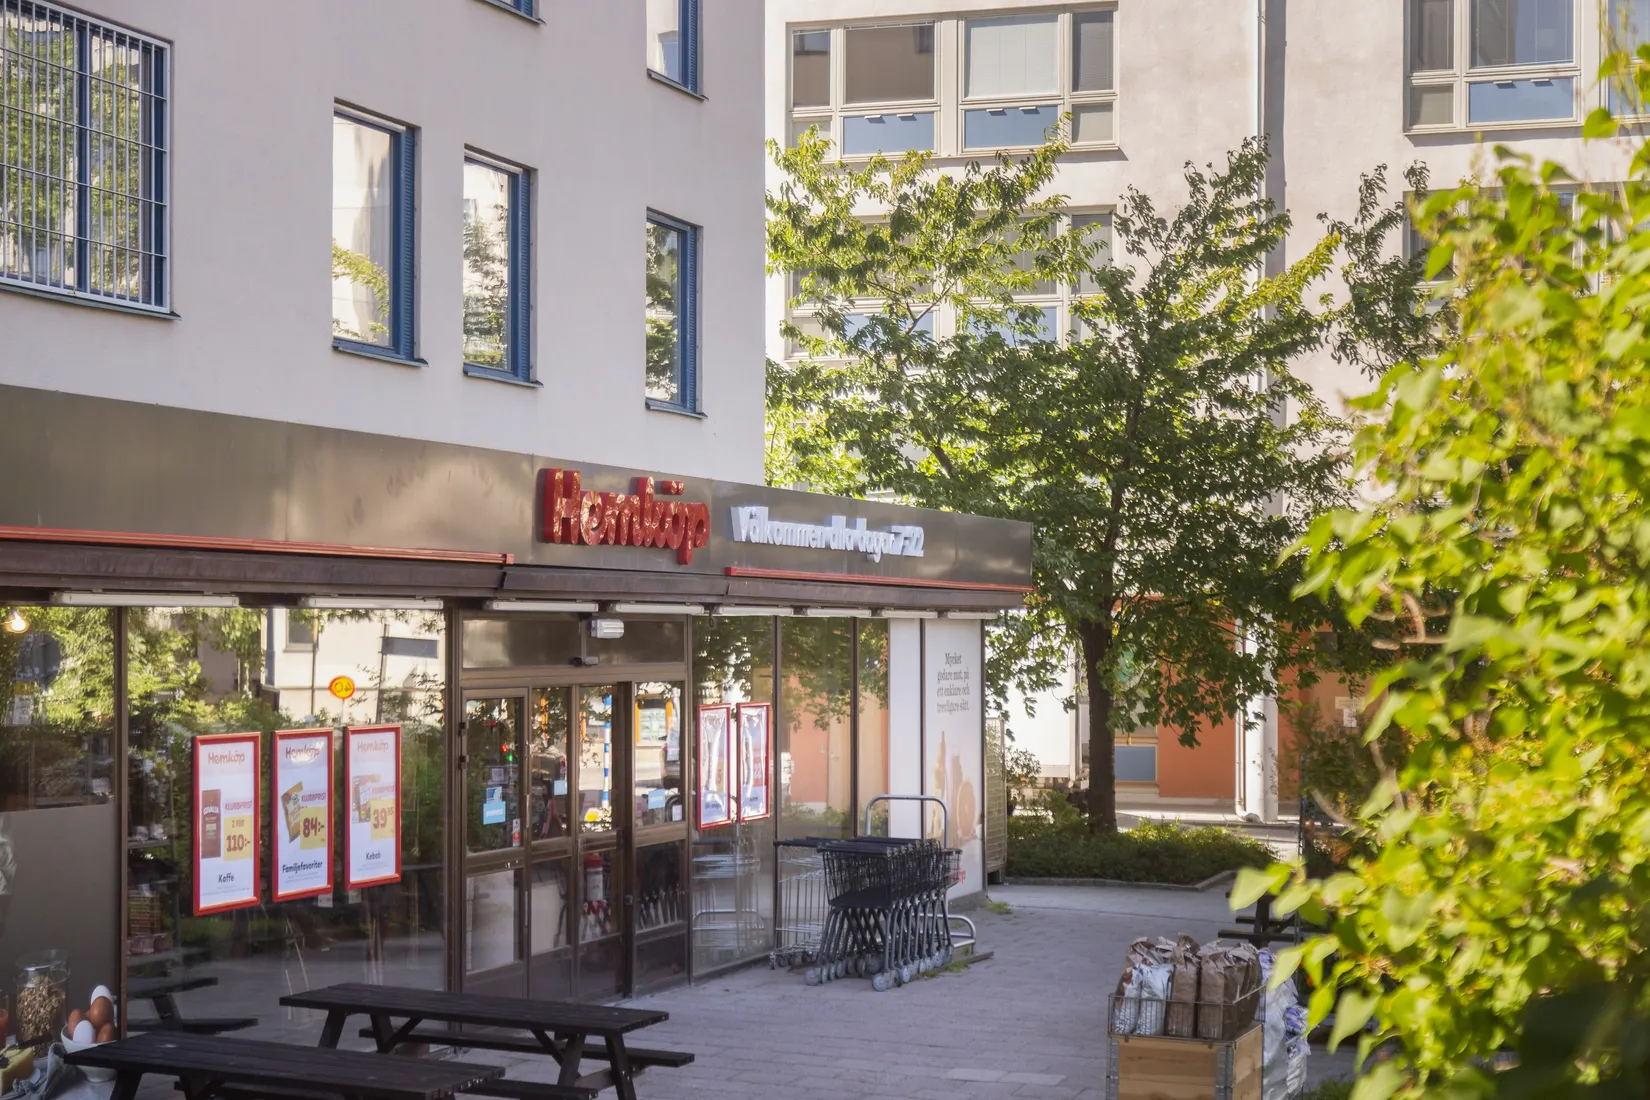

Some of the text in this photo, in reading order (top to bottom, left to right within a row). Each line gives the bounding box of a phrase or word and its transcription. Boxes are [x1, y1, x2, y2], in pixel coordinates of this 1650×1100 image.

[544, 468, 710, 565] Hemköp
[731, 506, 826, 549] Välkommen
[945, 652, 962, 667] Mycket
[357, 740, 389, 753] Hemköp
[208, 751, 246, 766] Hemköp
[365, 852, 381, 861] Kebab
[282, 860, 324, 874] Familjefavoriter
[218, 872, 235, 883] Kaffe
